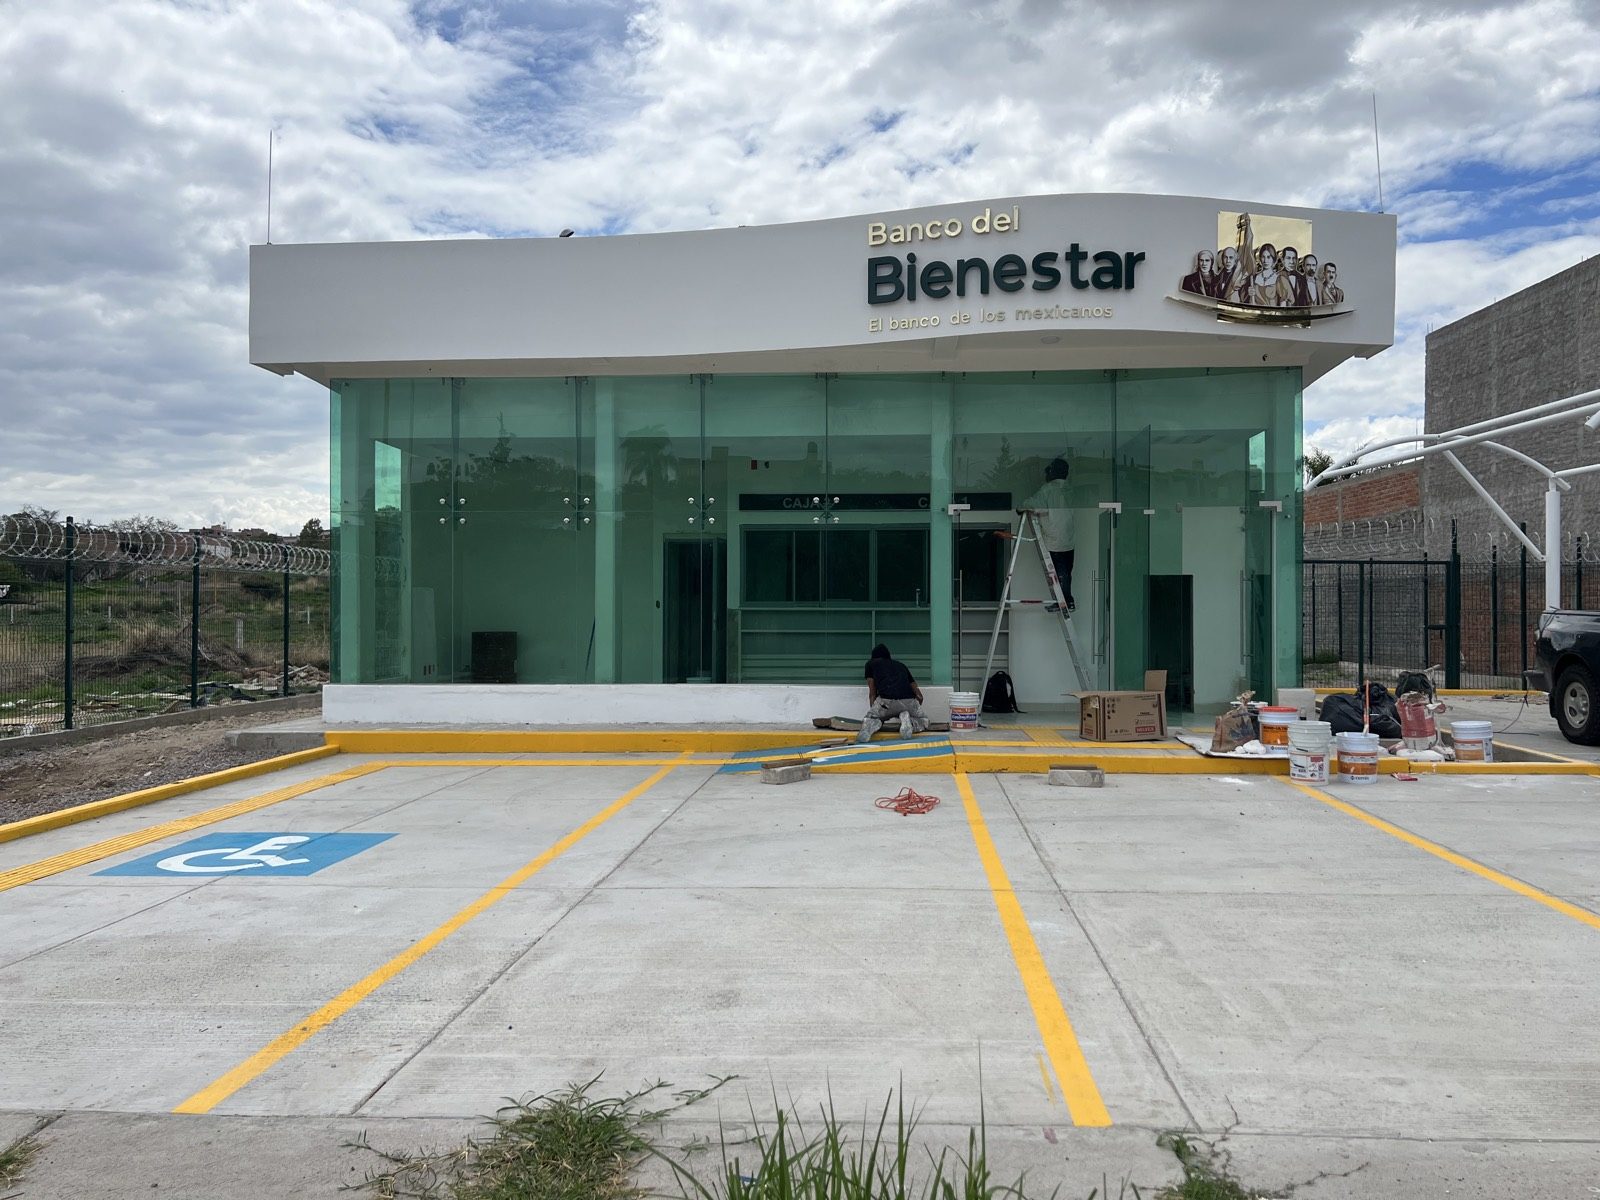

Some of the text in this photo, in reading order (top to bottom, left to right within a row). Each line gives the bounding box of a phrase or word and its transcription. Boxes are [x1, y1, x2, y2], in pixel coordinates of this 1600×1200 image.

[868, 205, 1019, 246] Banco del
[867, 243, 1146, 305] Bienestar
[868, 304, 1113, 332] El banco de los mexicanos
